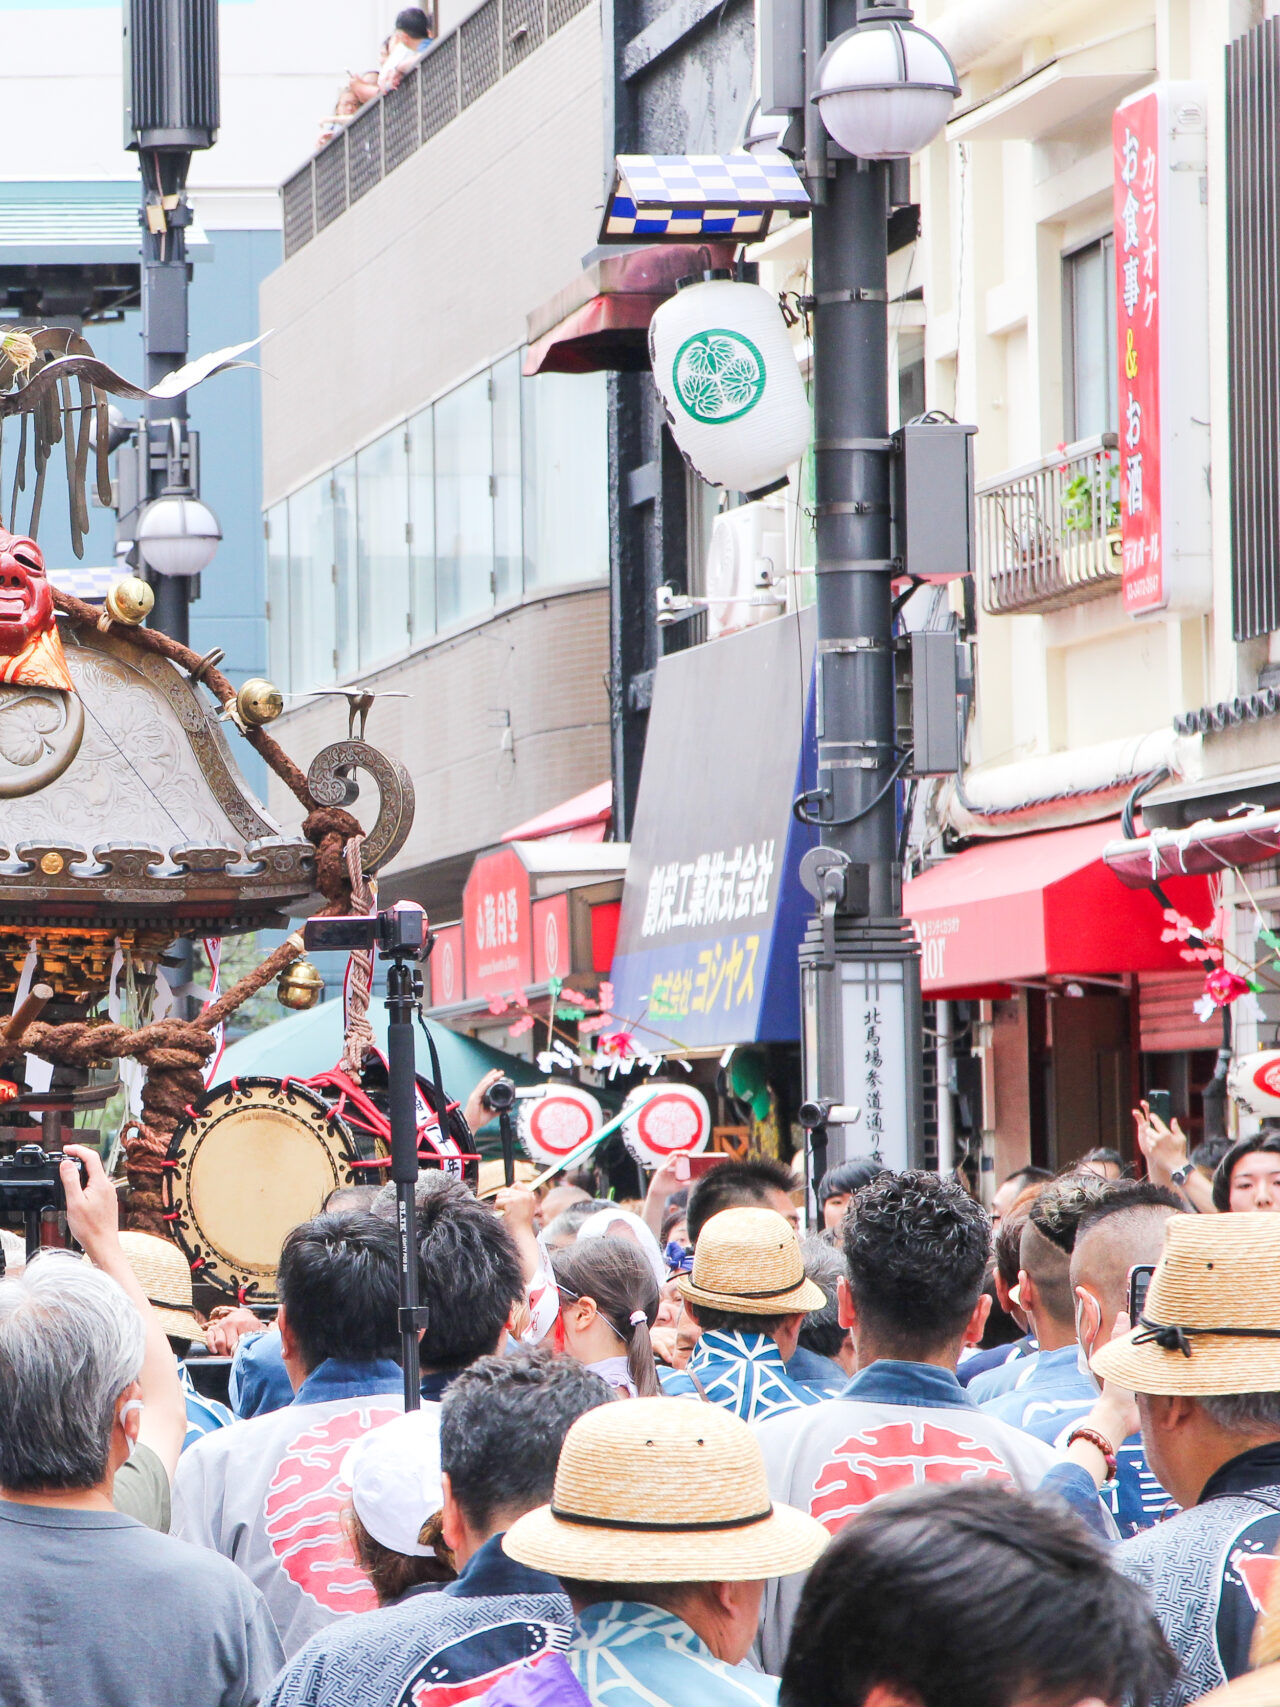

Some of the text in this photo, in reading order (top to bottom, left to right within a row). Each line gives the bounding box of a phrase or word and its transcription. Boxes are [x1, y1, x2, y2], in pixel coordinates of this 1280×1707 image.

[1142, 147, 1157, 328] カラオケ
[691, 934, 760, 1015] ヨシヤス
[399, 1201, 407, 1233] SLIK
